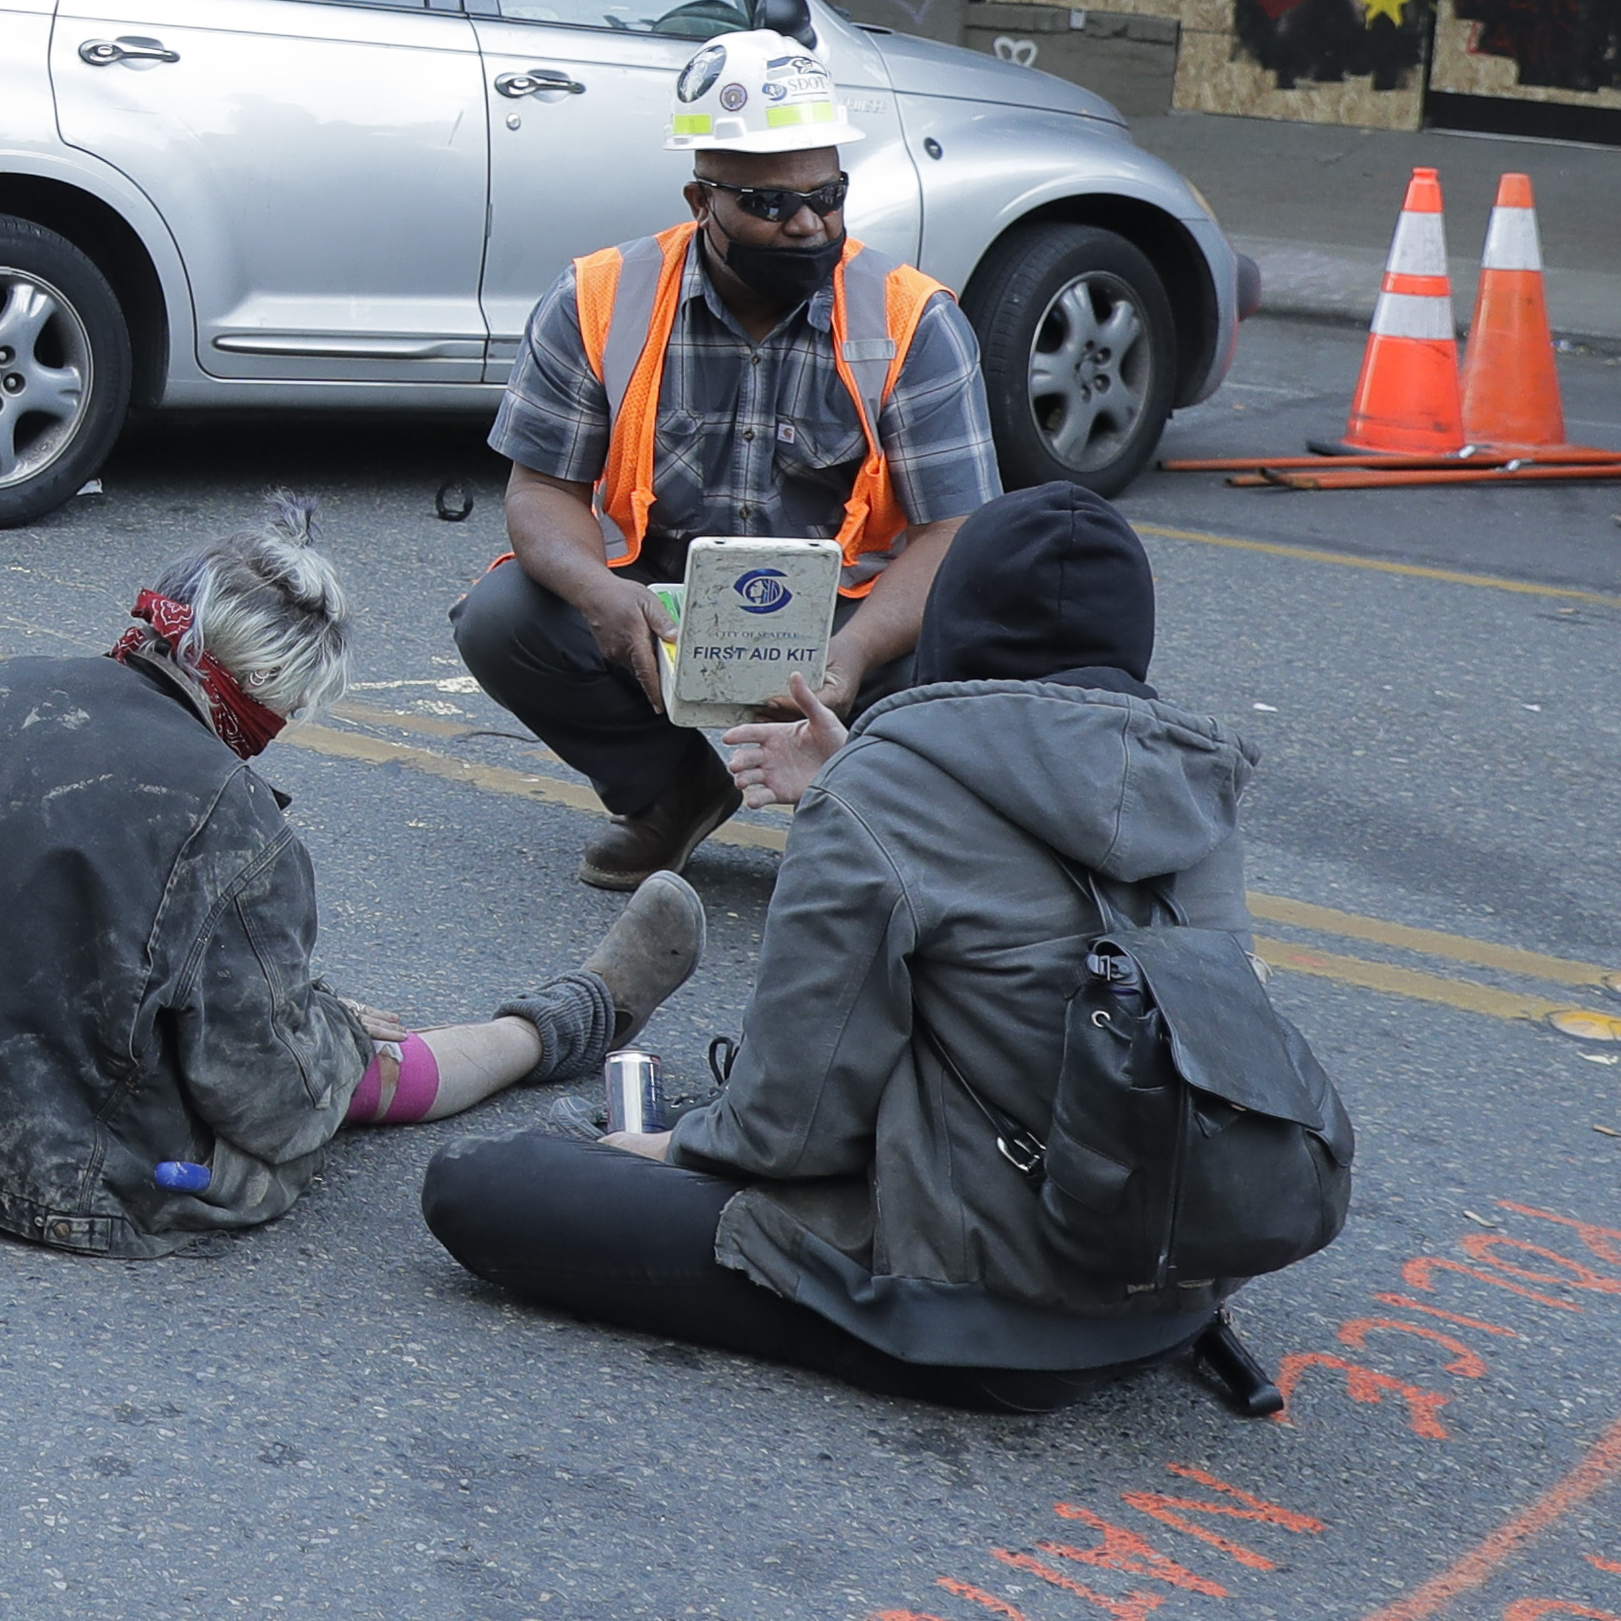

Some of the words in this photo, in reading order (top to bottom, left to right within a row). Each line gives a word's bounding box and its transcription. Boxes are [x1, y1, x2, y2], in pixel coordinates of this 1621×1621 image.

[787, 77, 827, 92] SDOT
[757, 631, 798, 639] SEATTLE
[693, 645, 748, 660] FIRST
[749, 647, 781, 661] AID
[786, 648, 818, 662] KIT
